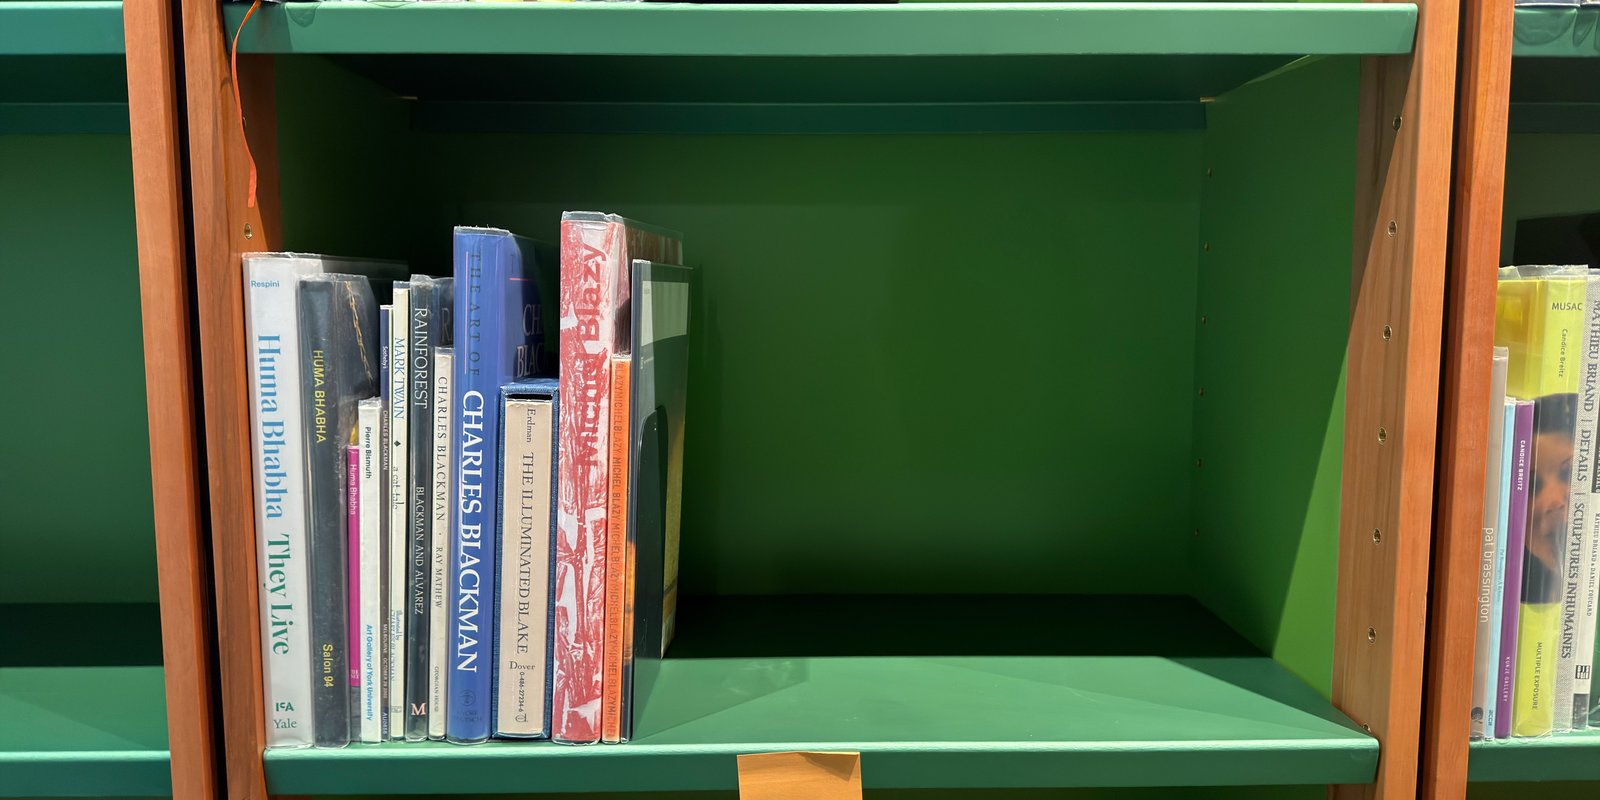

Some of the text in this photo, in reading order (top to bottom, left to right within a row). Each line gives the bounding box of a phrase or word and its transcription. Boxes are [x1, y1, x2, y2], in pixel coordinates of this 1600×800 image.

[250, 280, 280, 289] Respini
[575, 243, 607, 341] Blazy
[469, 306, 481, 342] ART
[1551, 302, 1583, 311] MUSAC
[394, 337, 406, 376] MARK
[469, 351, 481, 376] OF
[1558, 328, 1569, 378] Candice Breitz
[313, 350, 327, 444] HUMA BHABHA
[393, 377, 406, 419] TWAIN
[526, 408, 536, 443] Erdman
[365, 449, 373, 479] Bismuth
[414, 307, 428, 615] RAINFOREST BLACKMAN AND ALVAREZ
[461, 390, 484, 514] CHARLES
[1516, 440, 1526, 491] CANDICE BREITZ
[258, 333, 294, 656] Huma Bhabha They Live
[349, 464, 359, 516] Huma Bhabha
[434, 376, 448, 608] CHARLES BLACKMAN RAY MATHEW
[1561, 300, 1600, 659] MATHIEU BRIAND DETAILS SCULPTURES INHUMAINES
[516, 452, 534, 654] THE ILLUMINATED BLAKE
[1478, 527, 1495, 623] pat brassington
[456, 522, 482, 673] BLACKMAN
[323, 644, 334, 687] Salon 94
[365, 636, 373, 662] Gallery
[509, 661, 535, 670] Dover
[365, 687, 374, 721] University
[411, 703, 426, 716] M
[1532, 674, 1540, 710] EXPOSURE
[274, 718, 297, 729] Yale
